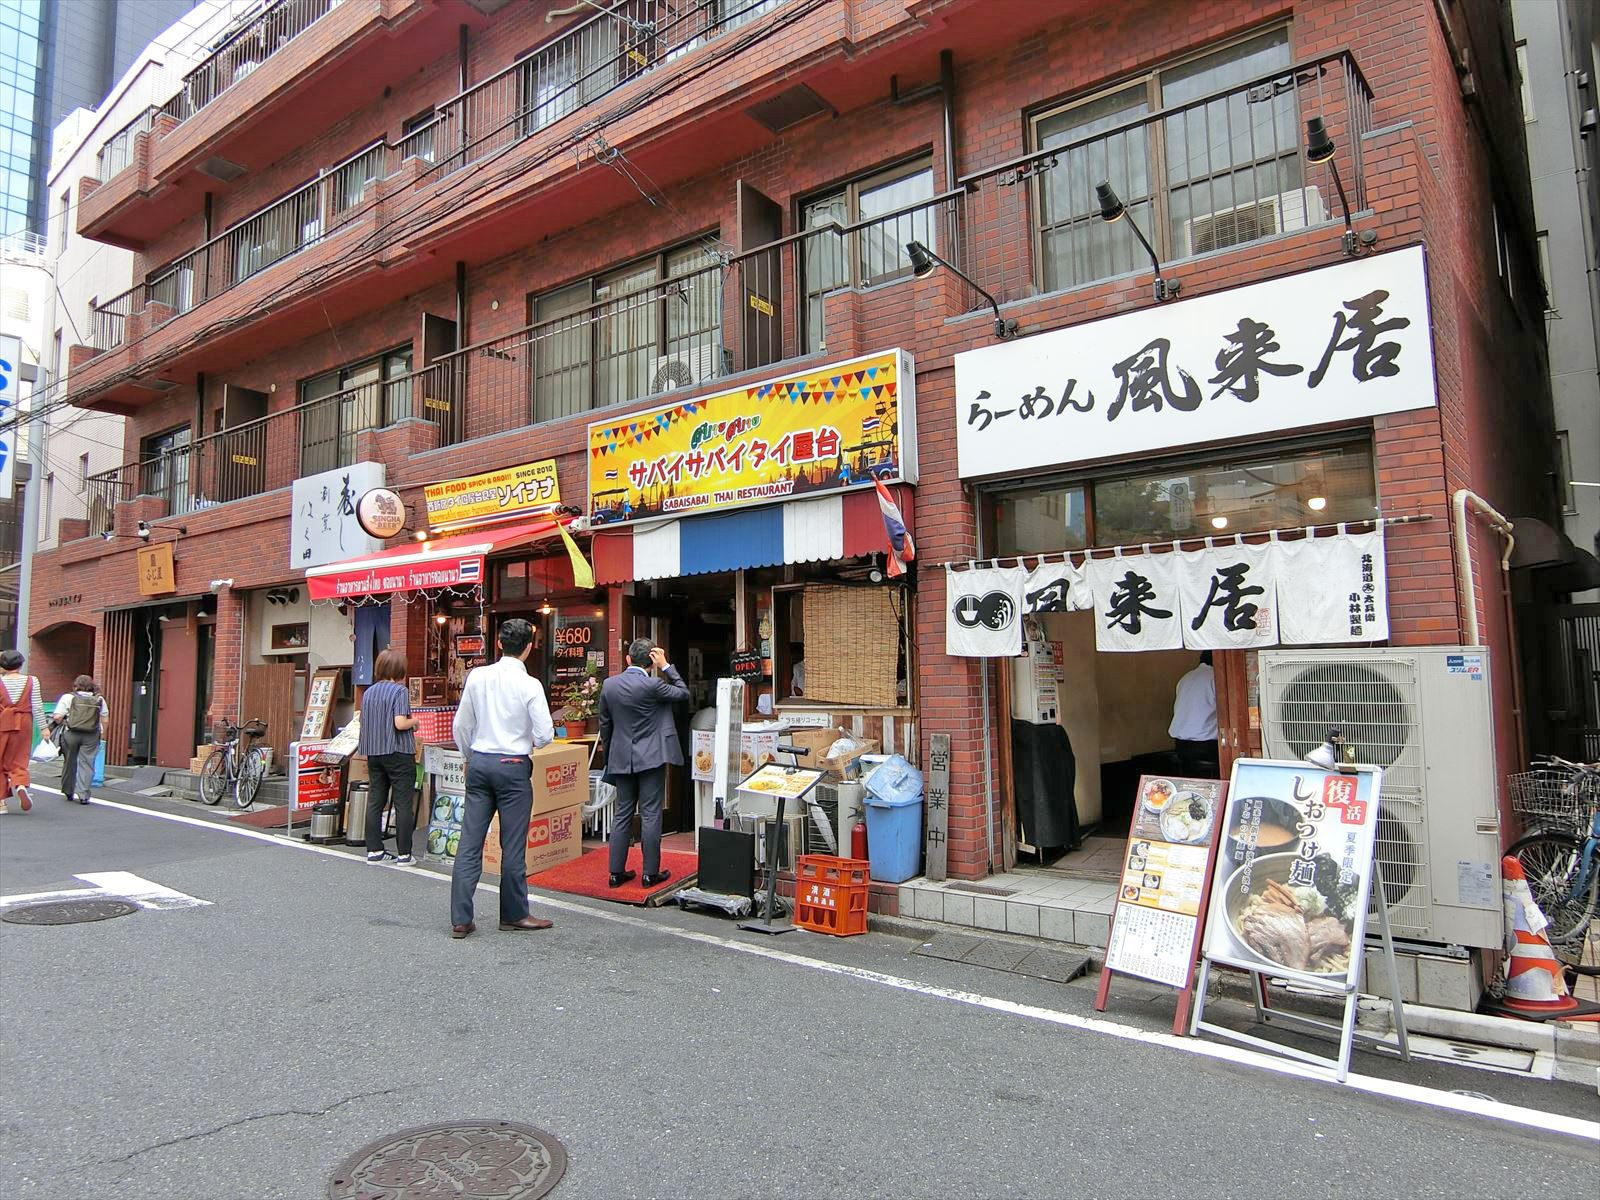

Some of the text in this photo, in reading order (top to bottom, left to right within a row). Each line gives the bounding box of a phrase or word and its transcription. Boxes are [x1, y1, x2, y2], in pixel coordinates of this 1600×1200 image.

[967, 290, 1411, 432] らーめん 風来居
[630, 428, 839, 487] サバイサバイタイ屋台
[425, 486, 443, 498] THAI
[445, 481, 467, 495] FOOD
[468, 479, 486, 488] SPICY
[516, 468, 536, 479] SINCE
[537, 465, 553, 475] 2010
[497, 476, 555, 507] ソイナナ
[664, 483, 792, 510] SABAISABAI THAI RESTAURANT
[372, 515, 401, 523] SINGHA
[555, 627, 591, 645] ¥680
[556, 646, 585, 658] タイ料理
[735, 661, 756, 671] OPEN
[562, 763, 577, 776] BF
[928, 750, 948, 848] 営業中
[1327, 780, 1362, 821] 復活
[550, 813, 572, 832] BF
[1288, 775, 1325, 886] しおつけ麺
[1339, 831, 1358, 884] 夏季限定
